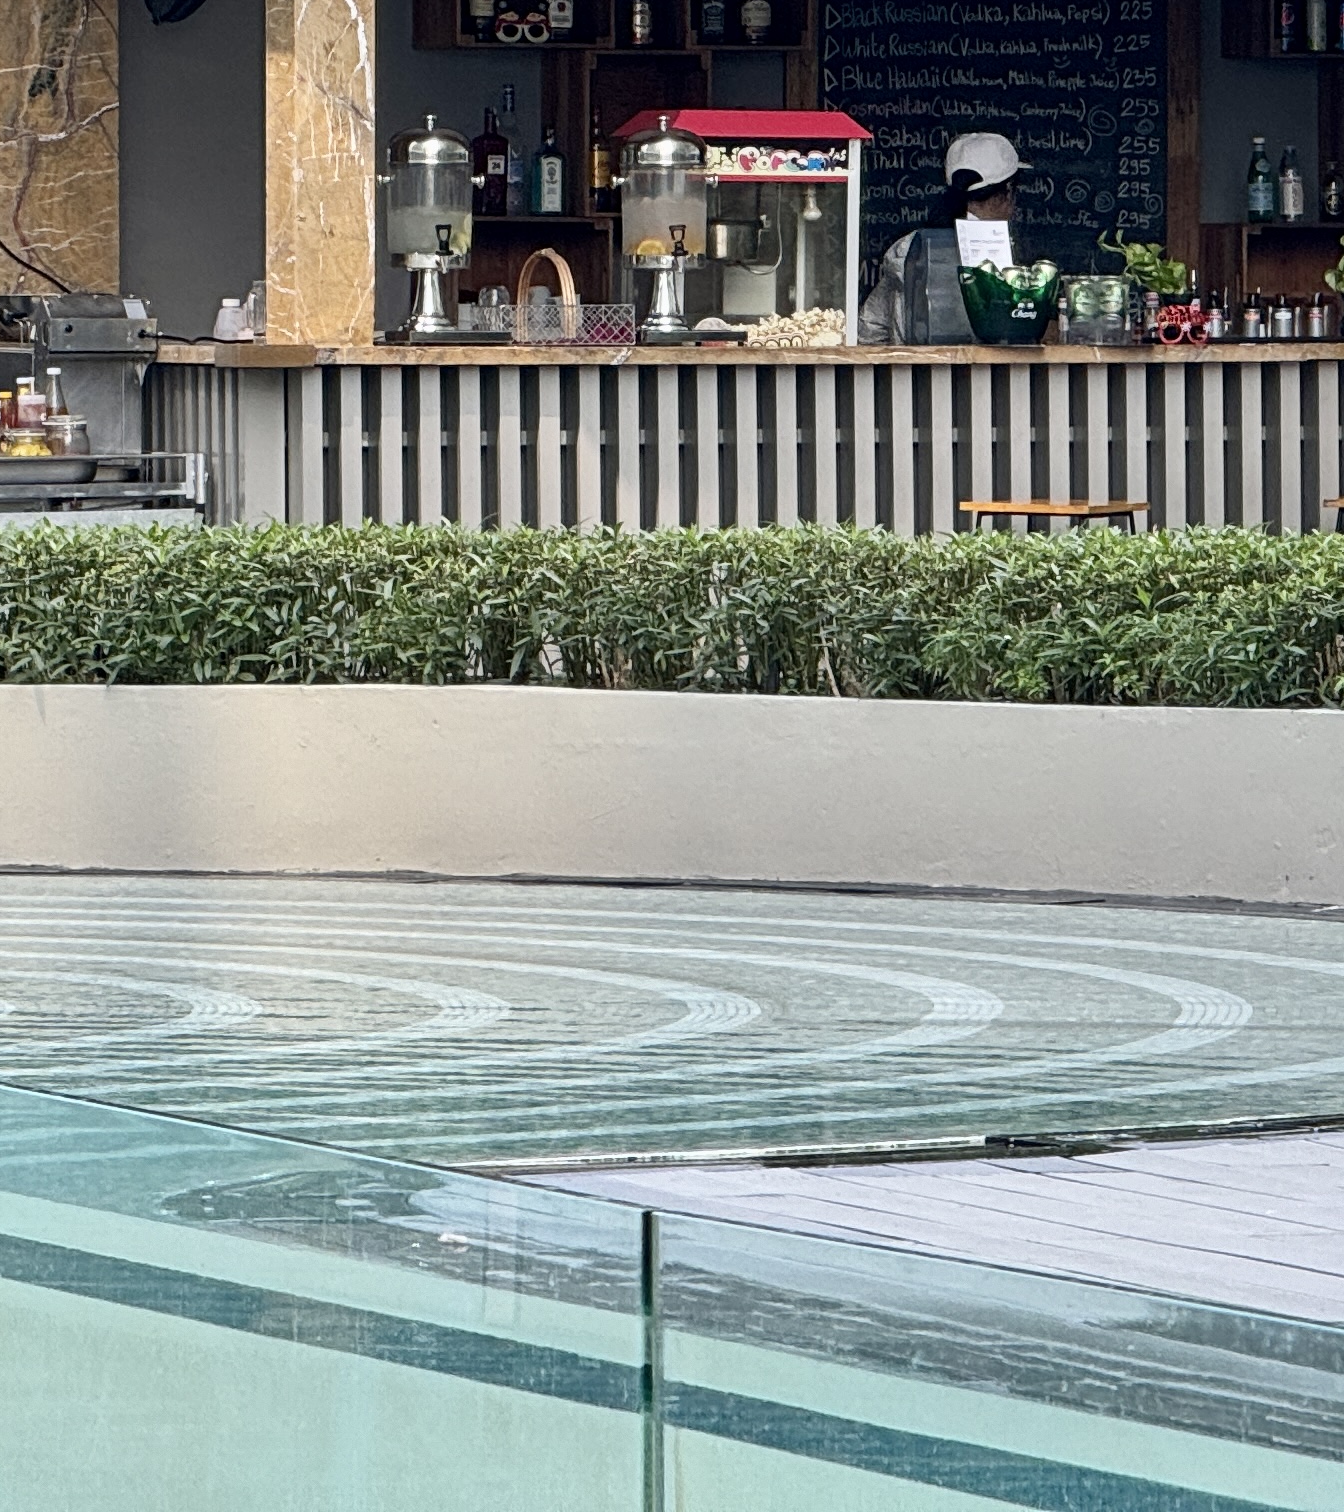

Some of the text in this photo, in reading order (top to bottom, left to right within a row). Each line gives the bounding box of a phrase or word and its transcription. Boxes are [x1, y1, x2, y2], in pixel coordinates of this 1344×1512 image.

[842, 0, 883, 29] Black
[885, 0, 948, 24] Russian
[1012, 1, 1066, 25] Kahlua,
[1120, 0, 1153, 21] 225
[842, 32, 887, 59] White
[888, 33, 948, 57] Russian
[1113, 34, 1151, 53] 225
[841, 65, 884, 92] Blue
[887, 65, 941, 90] Hawaii
[1122, 66, 1156, 89] 235
[1120, 97, 1159, 117] 255
[1118, 136, 1160, 155] 255
[1118, 157, 1151, 175] 295
[1117, 180, 1152, 198] 295
[1116, 209, 1152, 229] 295
